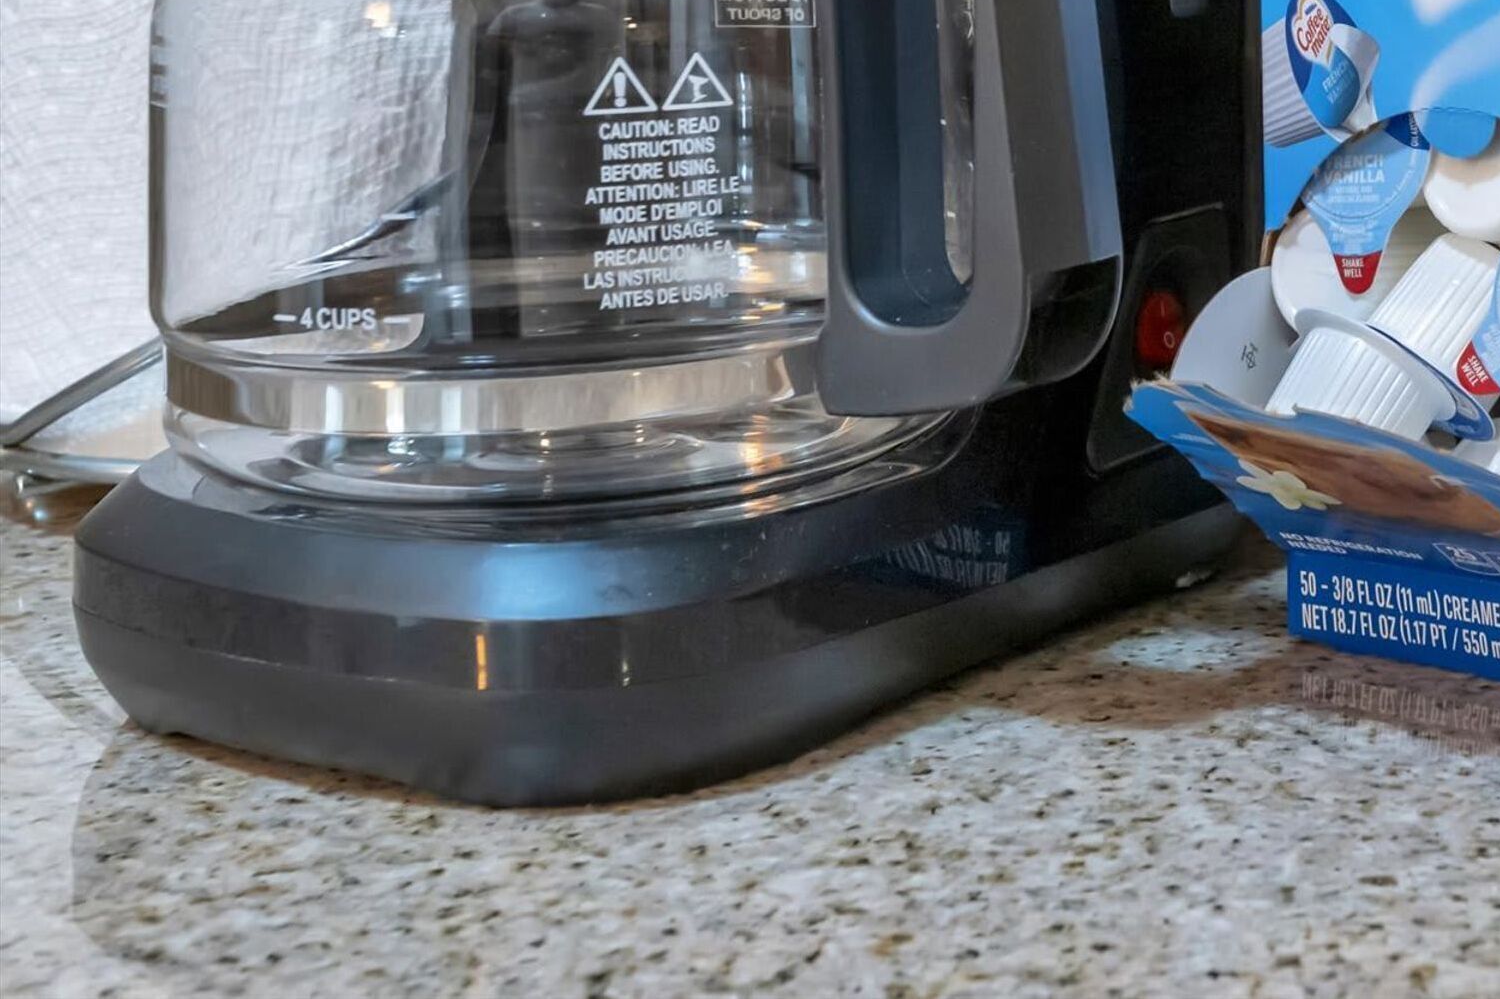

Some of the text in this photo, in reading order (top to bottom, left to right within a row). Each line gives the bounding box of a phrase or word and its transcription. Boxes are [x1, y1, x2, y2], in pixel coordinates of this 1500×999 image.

[598, 115, 721, 141] CAUTION: READ
[602, 137, 716, 161] INSTRUCTIONS
[601, 157, 719, 183] BEFORE USING.
[585, 175, 740, 205] ATTENTION: LIRE LE
[600, 198, 722, 224] MODE D'EMPLOI
[606, 220, 718, 246] AVANT USAGE.
[584, 272, 615, 290] LAS
[600, 281, 729, 310] ANTES DE USAR.
[299, 307, 377, 330] 4 CUPS
[1299, 570, 1317, 597] 50
[1332, 575, 1355, 605] 3/8
[1357, 579, 1374, 606] FL
[1376, 582, 1394, 609] OZ
[1396, 582, 1413, 613] (11
[1416, 589, 1440, 620] mL)
[1301, 603, 1329, 632] NET
[1330, 606, 1357, 636] 18.7
[1360, 611, 1377, 638] FL
[1379, 614, 1398, 642] OZ
[1400, 613, 1427, 646] (1.17
[1430, 623, 1448, 649] PT
[1462, 629, 1488, 657] 550
